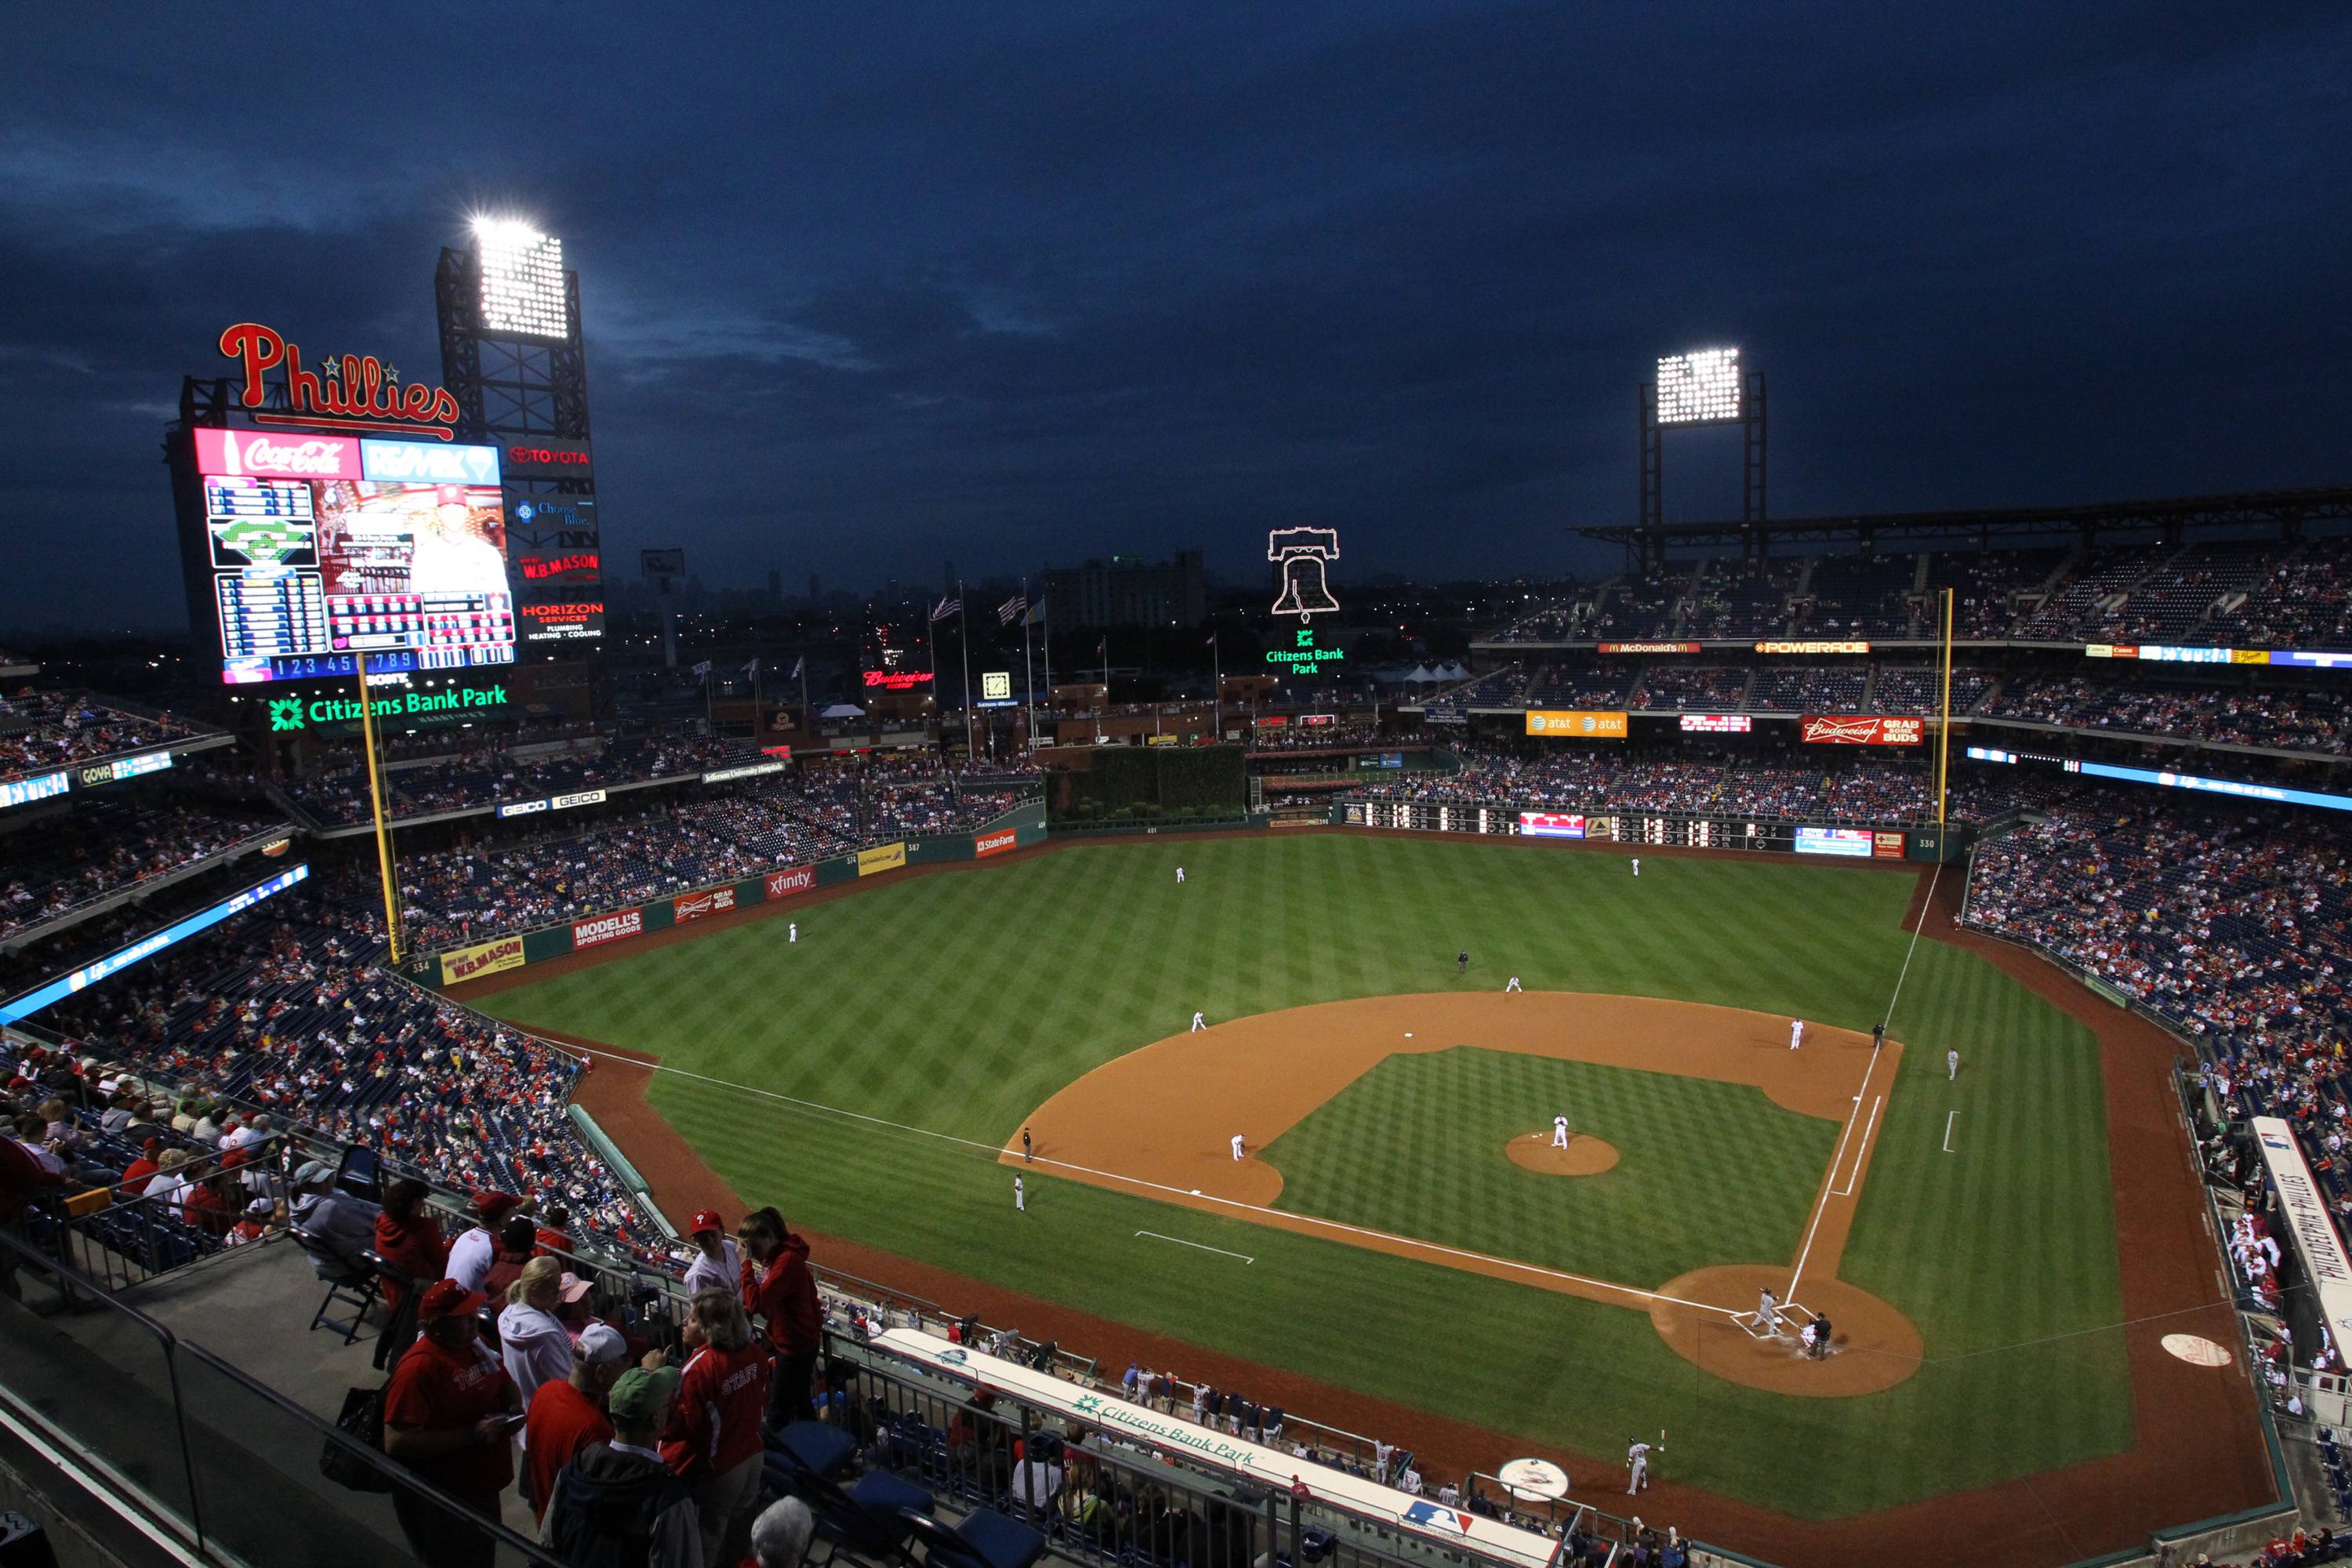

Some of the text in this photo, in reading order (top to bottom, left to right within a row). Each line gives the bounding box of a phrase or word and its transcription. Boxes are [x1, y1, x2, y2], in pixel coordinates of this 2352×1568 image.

[219, 322, 460, 423] Phillies
[529, 449, 590, 464] TOYOTA
[521, 604, 604, 616] HORIZON
[539, 615, 588, 623] SERVICES
[568, 630, 601, 638] COOLING
[1621, 644, 1678, 652] McDonald's
[1766, 641, 1867, 653] POWERADE
[1266, 648, 1344, 662] Citizens Bank
[278, 660, 284, 675] 1
[292, 659, 301, 674] 2
[306, 658, 314, 673] 3
[327, 657, 336, 671] 4
[341, 656, 350, 670] 5
[376, 654, 383, 667] 7
[389, 653, 397, 666] 8
[402, 652, 410, 666] 9
[1293, 662, 1317, 674] Park
[863, 670, 934, 687] Budweiser
[310, 684, 507, 722] Citizens Bank Park
[1548, 717, 1571, 728] at&t
[1598, 718, 1623, 730] at&t
[1805, 723, 1878, 735] Budweiser
[1883, 720, 1919, 728] GRAB
[82, 765, 112, 783] GOYA
[706, 763, 782, 783] Jefferson University Hospitals
[559, 792, 600, 807] GEICO
[501, 800, 546, 816] GEICO
[1919, 839, 1934, 848] 330
[770, 872, 811, 894] xfinity
[713, 890, 733, 899] GRAB
[714, 899, 734, 909] BUDS
[575, 912, 640, 939] MODELL'S
[577, 924, 641, 946] SPORTING GOODS
[412, 961, 429, 974] 334
[2279, 1174, 2347, 1280] PHILADELPHIA PHILLIES
[722, 1363, 757, 1396] STAFF
[1102, 1406, 1255, 1464] Citizens Bank Park
